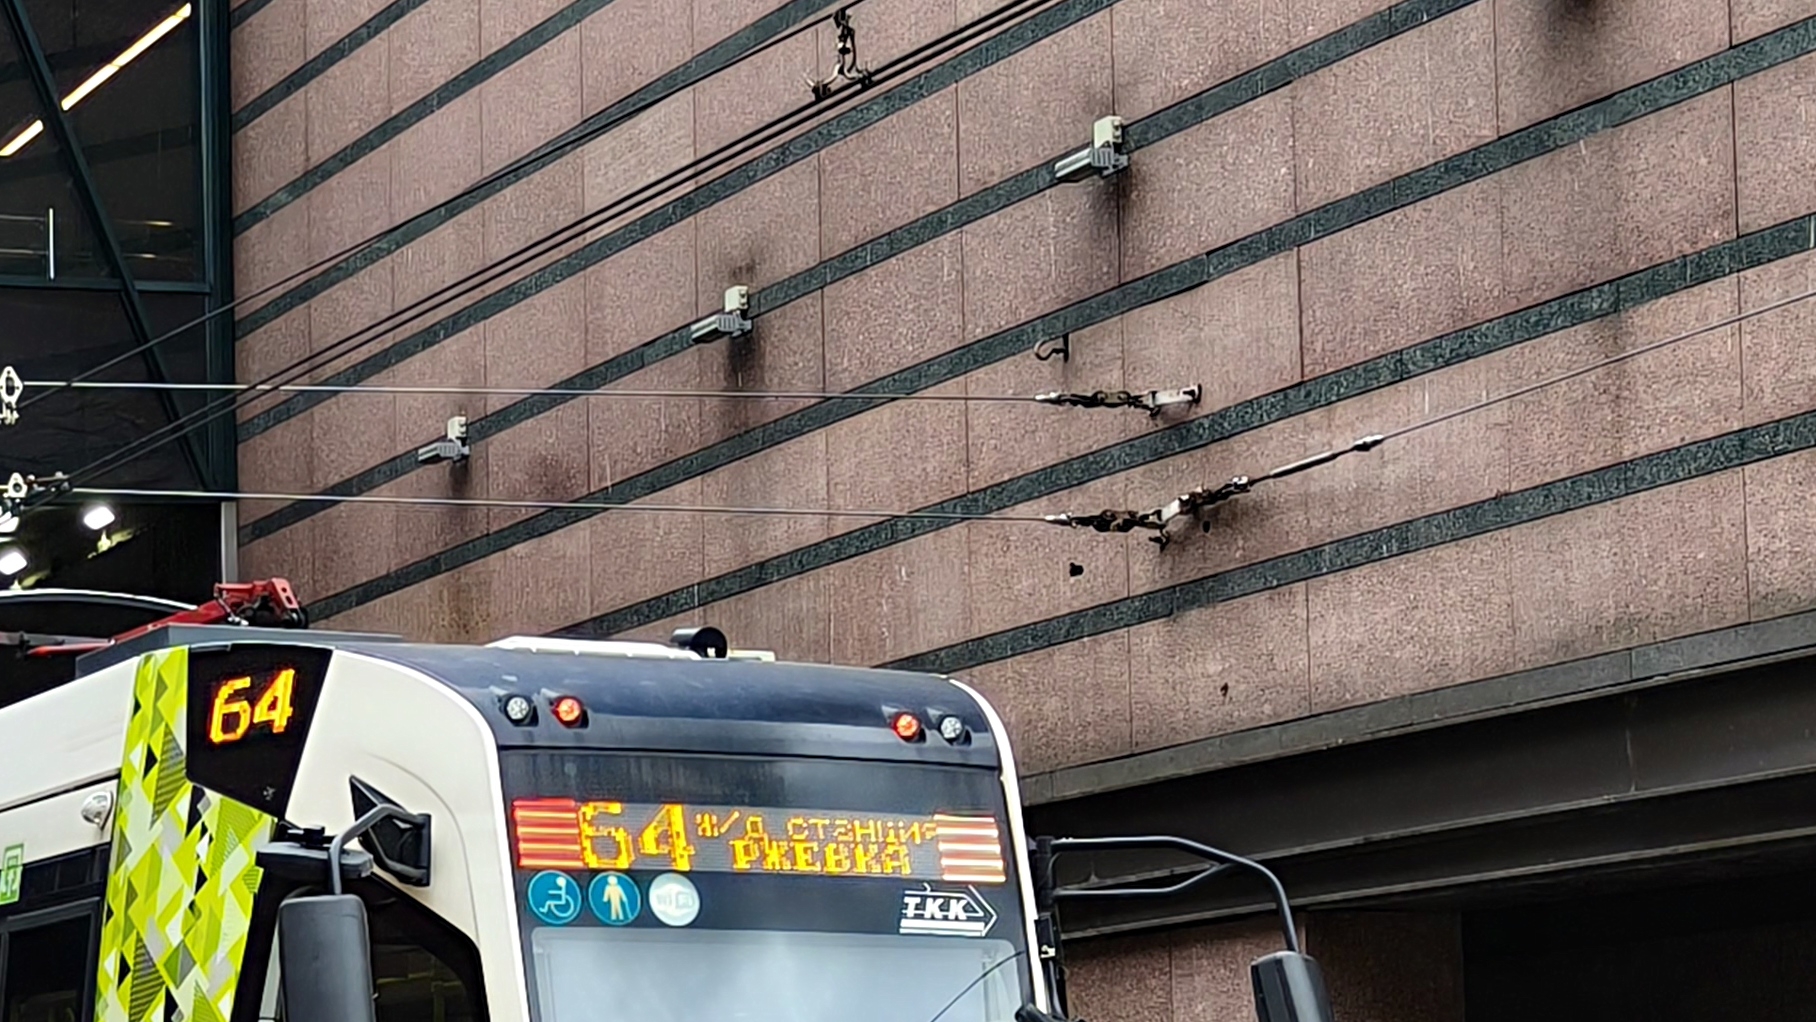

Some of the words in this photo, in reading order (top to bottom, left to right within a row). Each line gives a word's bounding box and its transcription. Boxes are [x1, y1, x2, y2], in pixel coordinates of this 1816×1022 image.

[210, 668, 294, 743] 64
[581, 802, 694, 871] 64
[730, 839, 912, 875] РЖЕВКА
[903, 896, 969, 920] ТКК
